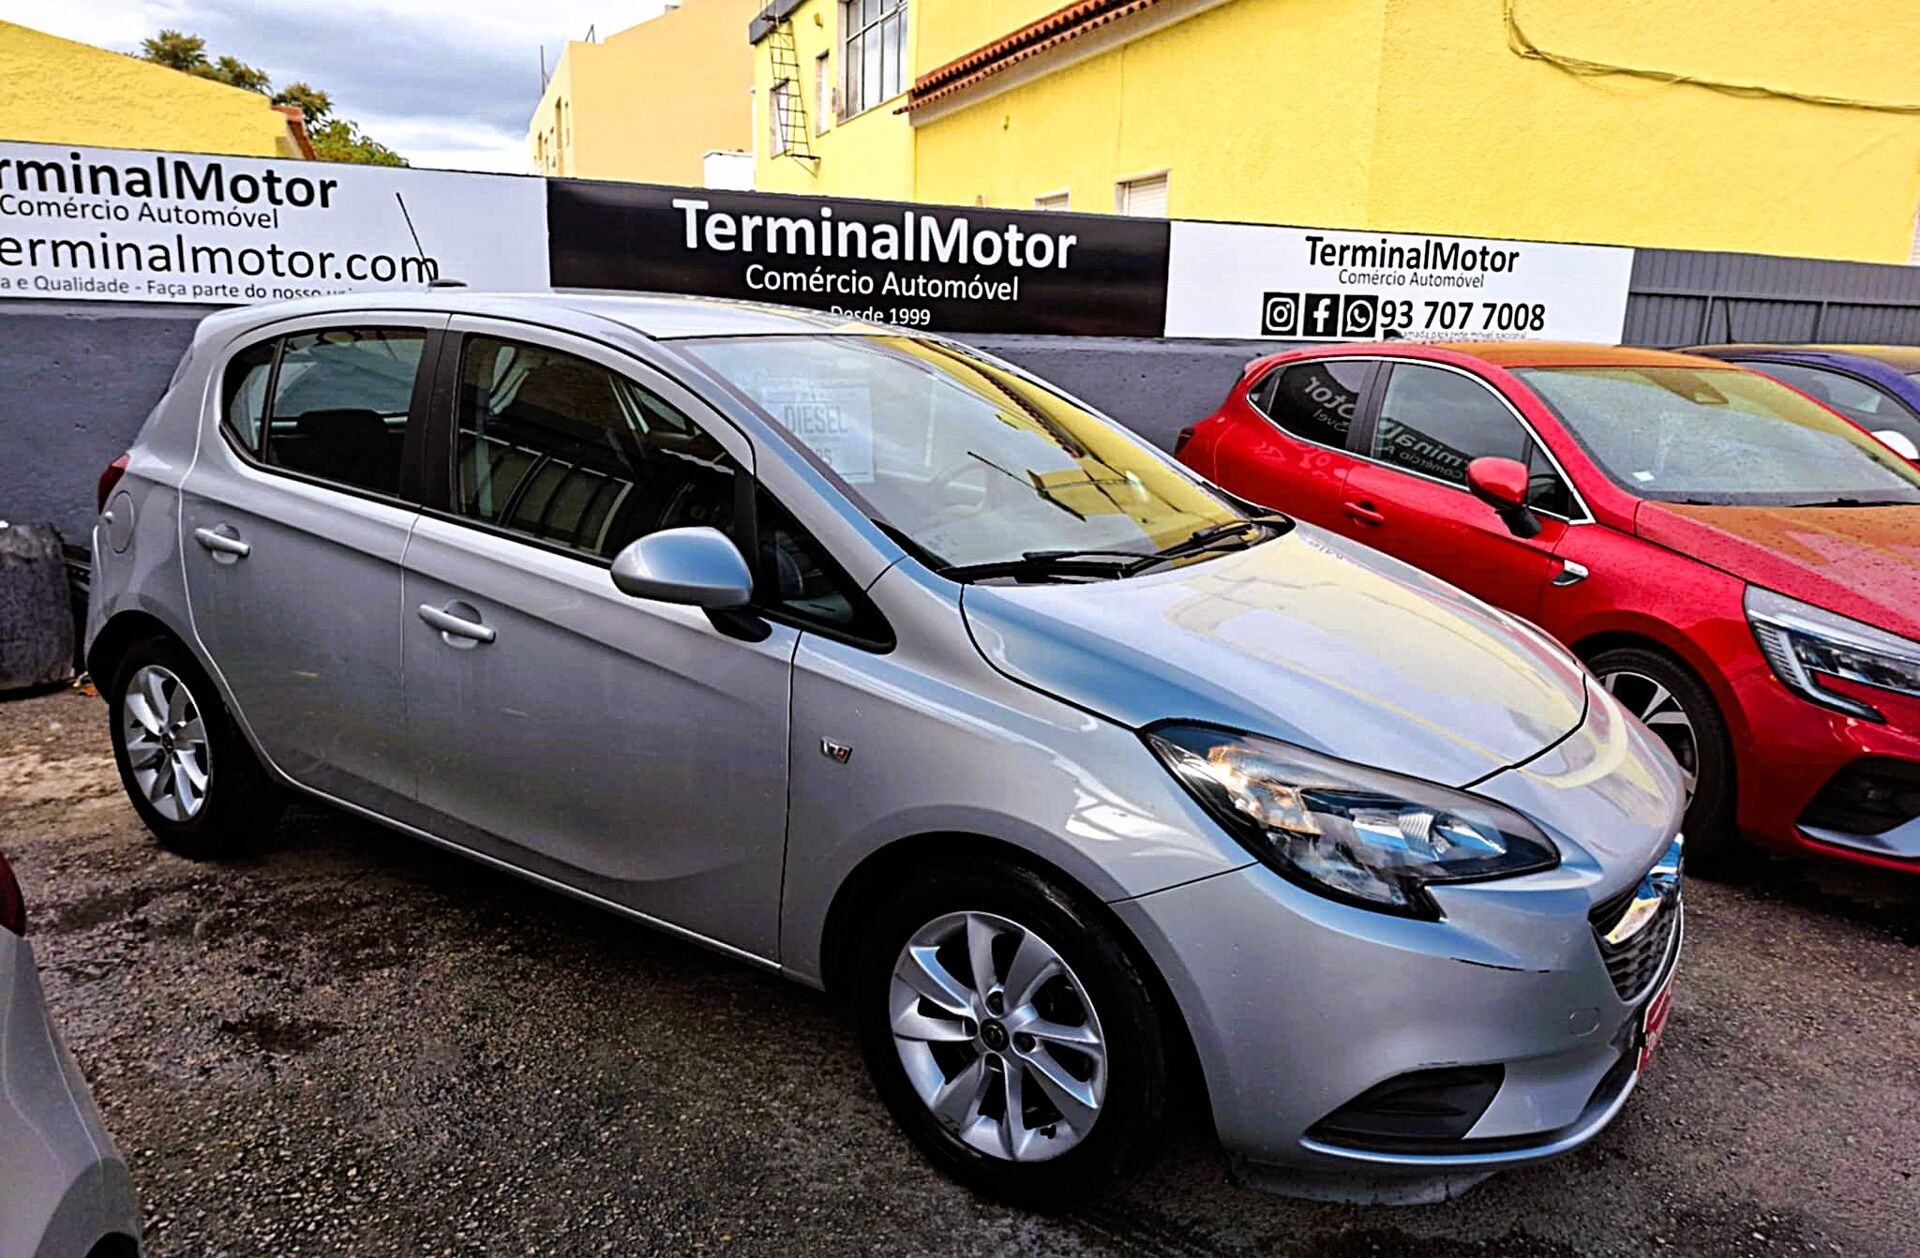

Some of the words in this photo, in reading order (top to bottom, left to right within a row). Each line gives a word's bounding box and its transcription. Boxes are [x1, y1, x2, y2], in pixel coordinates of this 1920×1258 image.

[0, 193, 129, 221] Comércio
[138, 201, 279, 229] Automóvel
[672, 199, 1077, 269] TerminalMotor
[0, 232, 439, 284] erminalmotor.com
[1306, 236, 1520, 273] TerminalMotor
[17, 278, 28, 289] e
[34, 275, 130, 293] Qualidade
[147, 280, 187, 299] Faça
[192, 284, 239, 301] parte
[245, 283, 267, 298] do
[746, 264, 874, 297] Comércio
[881, 271, 1018, 302] Automóvel
[1338, 268, 1406, 287] Comércio
[1410, 271, 1484, 289] Automóvel
[889, 308, 931, 326] 1999
[1380, 300, 1414, 329] 93
[1424, 301, 1474, 330] 707
[1482, 302, 1546, 332] 7008
[783, 405, 849, 435] DIESEL
